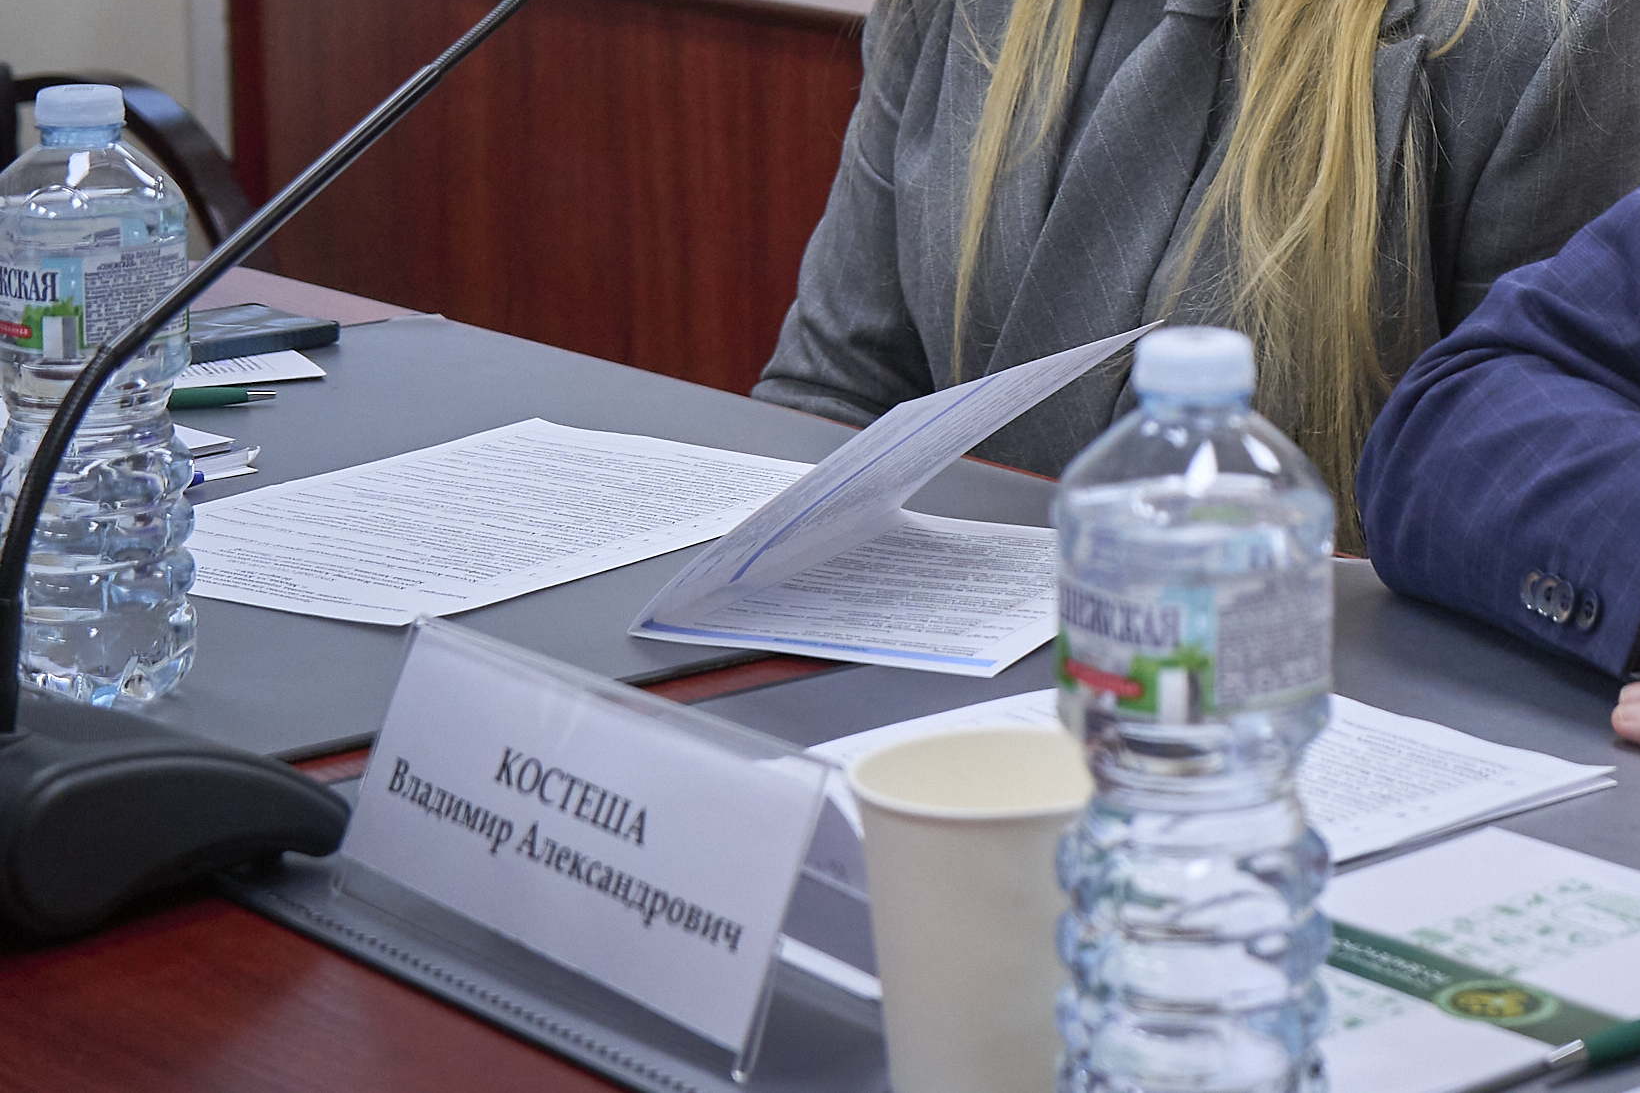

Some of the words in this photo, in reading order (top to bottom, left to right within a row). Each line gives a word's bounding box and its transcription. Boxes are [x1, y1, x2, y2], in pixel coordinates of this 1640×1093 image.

[388, 757, 514, 855] Владимир
[516, 821, 744, 952] Александрович
[495, 747, 648, 846] КОСТЕША
